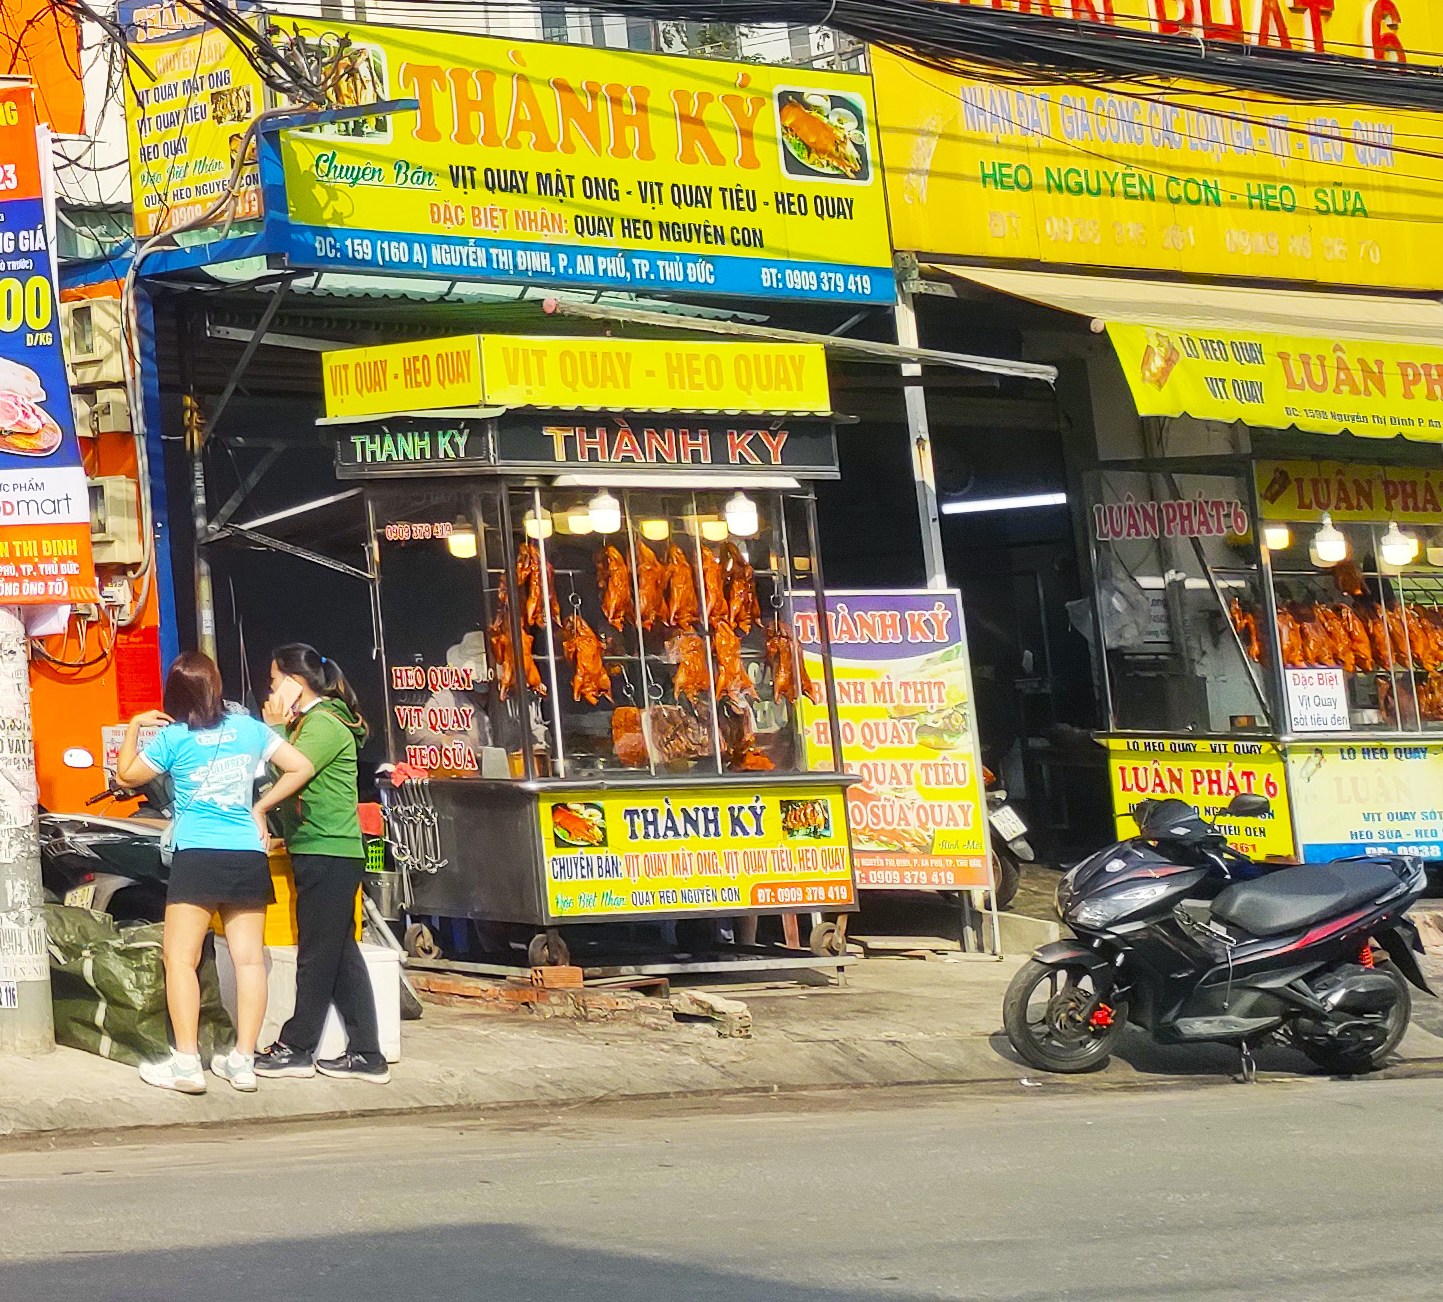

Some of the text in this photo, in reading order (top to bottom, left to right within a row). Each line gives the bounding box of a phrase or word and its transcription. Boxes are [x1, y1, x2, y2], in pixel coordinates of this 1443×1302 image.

[399, 49, 766, 171] THÀNH KÝ
[315, 150, 385, 188] Chuyên
[449, 164, 476, 195] VỊT
[484, 167, 529, 194] QUAY
[536, 169, 575, 203] MẬT
[582, 175, 619, 202] ONG
[637, 180, 663, 211] VỊT
[670, 182, 712, 210] QUAY
[719, 183, 757, 213] TIÊU
[774, 191, 808, 217] HEO
[813, 194, 854, 221] QUAY
[980, 160, 1369, 218] HEO NGUYÊN CON HEO SỮA
[19, 224, 47, 253] GIÁ
[430, 200, 765, 248] ĐẶC BIỆT NHẬN: QUAY HEO NGUYÊN CON
[315, 237, 872, 295] ĐC: 159 (160 A) NGUYỄN THỊ ĐỊNH, P. AN PHÚ, TP. THỦ ĐỨC ĐT: 0909 379 419
[501, 346, 806, 395] VỊT QUAY HEO QUAY
[542, 416, 714, 464] THÀNH
[12, 478, 45, 493] PHẨM
[16, 493, 72, 516] mart
[1093, 489, 1248, 540] LUÂN PHÁT 6
[392, 665, 473, 693] HEO QUAY
[871, 675, 947, 712] MÌ THỊT
[1292, 673, 1315, 690] Đặc
[394, 705, 474, 734] VỊT QUAY
[1314, 695, 1337, 712] Quay
[861, 721, 917, 747] QUAY
[406, 740, 478, 771] HEO SỮA
[861, 755, 967, 787] QUAY TIÊU
[1118, 759, 1279, 800] LUÂN PHÁT 6
[623, 796, 722, 840] THÀNH
[871, 796, 913, 828] SỮA
[915, 802, 974, 829] QUAY
